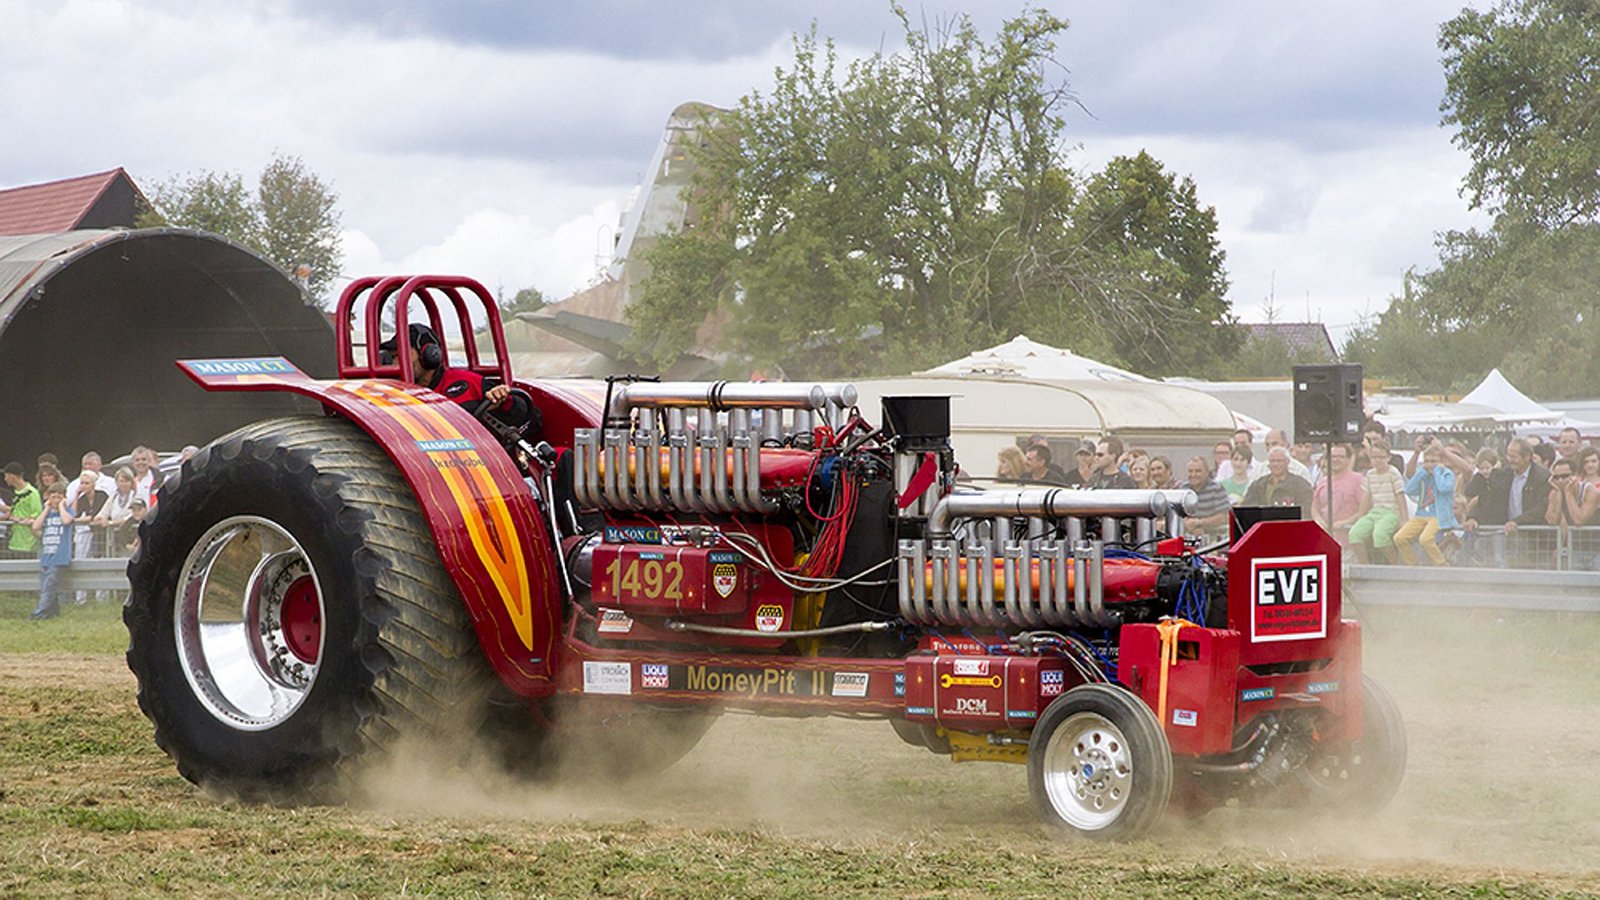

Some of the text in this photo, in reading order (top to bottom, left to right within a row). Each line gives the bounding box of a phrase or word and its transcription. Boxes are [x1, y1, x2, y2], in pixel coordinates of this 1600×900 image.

[195, 361, 261, 373] MASON
[419, 441, 456, 450] MASON
[608, 528, 646, 540] MASON
[710, 553, 734, 562] MASON
[605, 558, 684, 600] 1492
[1258, 567, 1318, 605] EVG
[642, 664, 668, 675] LIQUI
[642, 675, 668, 687] MOLY
[1041, 672, 1064, 683] LIQUI
[1041, 684, 1063, 695] MOLY
[1242, 690, 1264, 701] MASON
[956, 698, 987, 712] DCM
